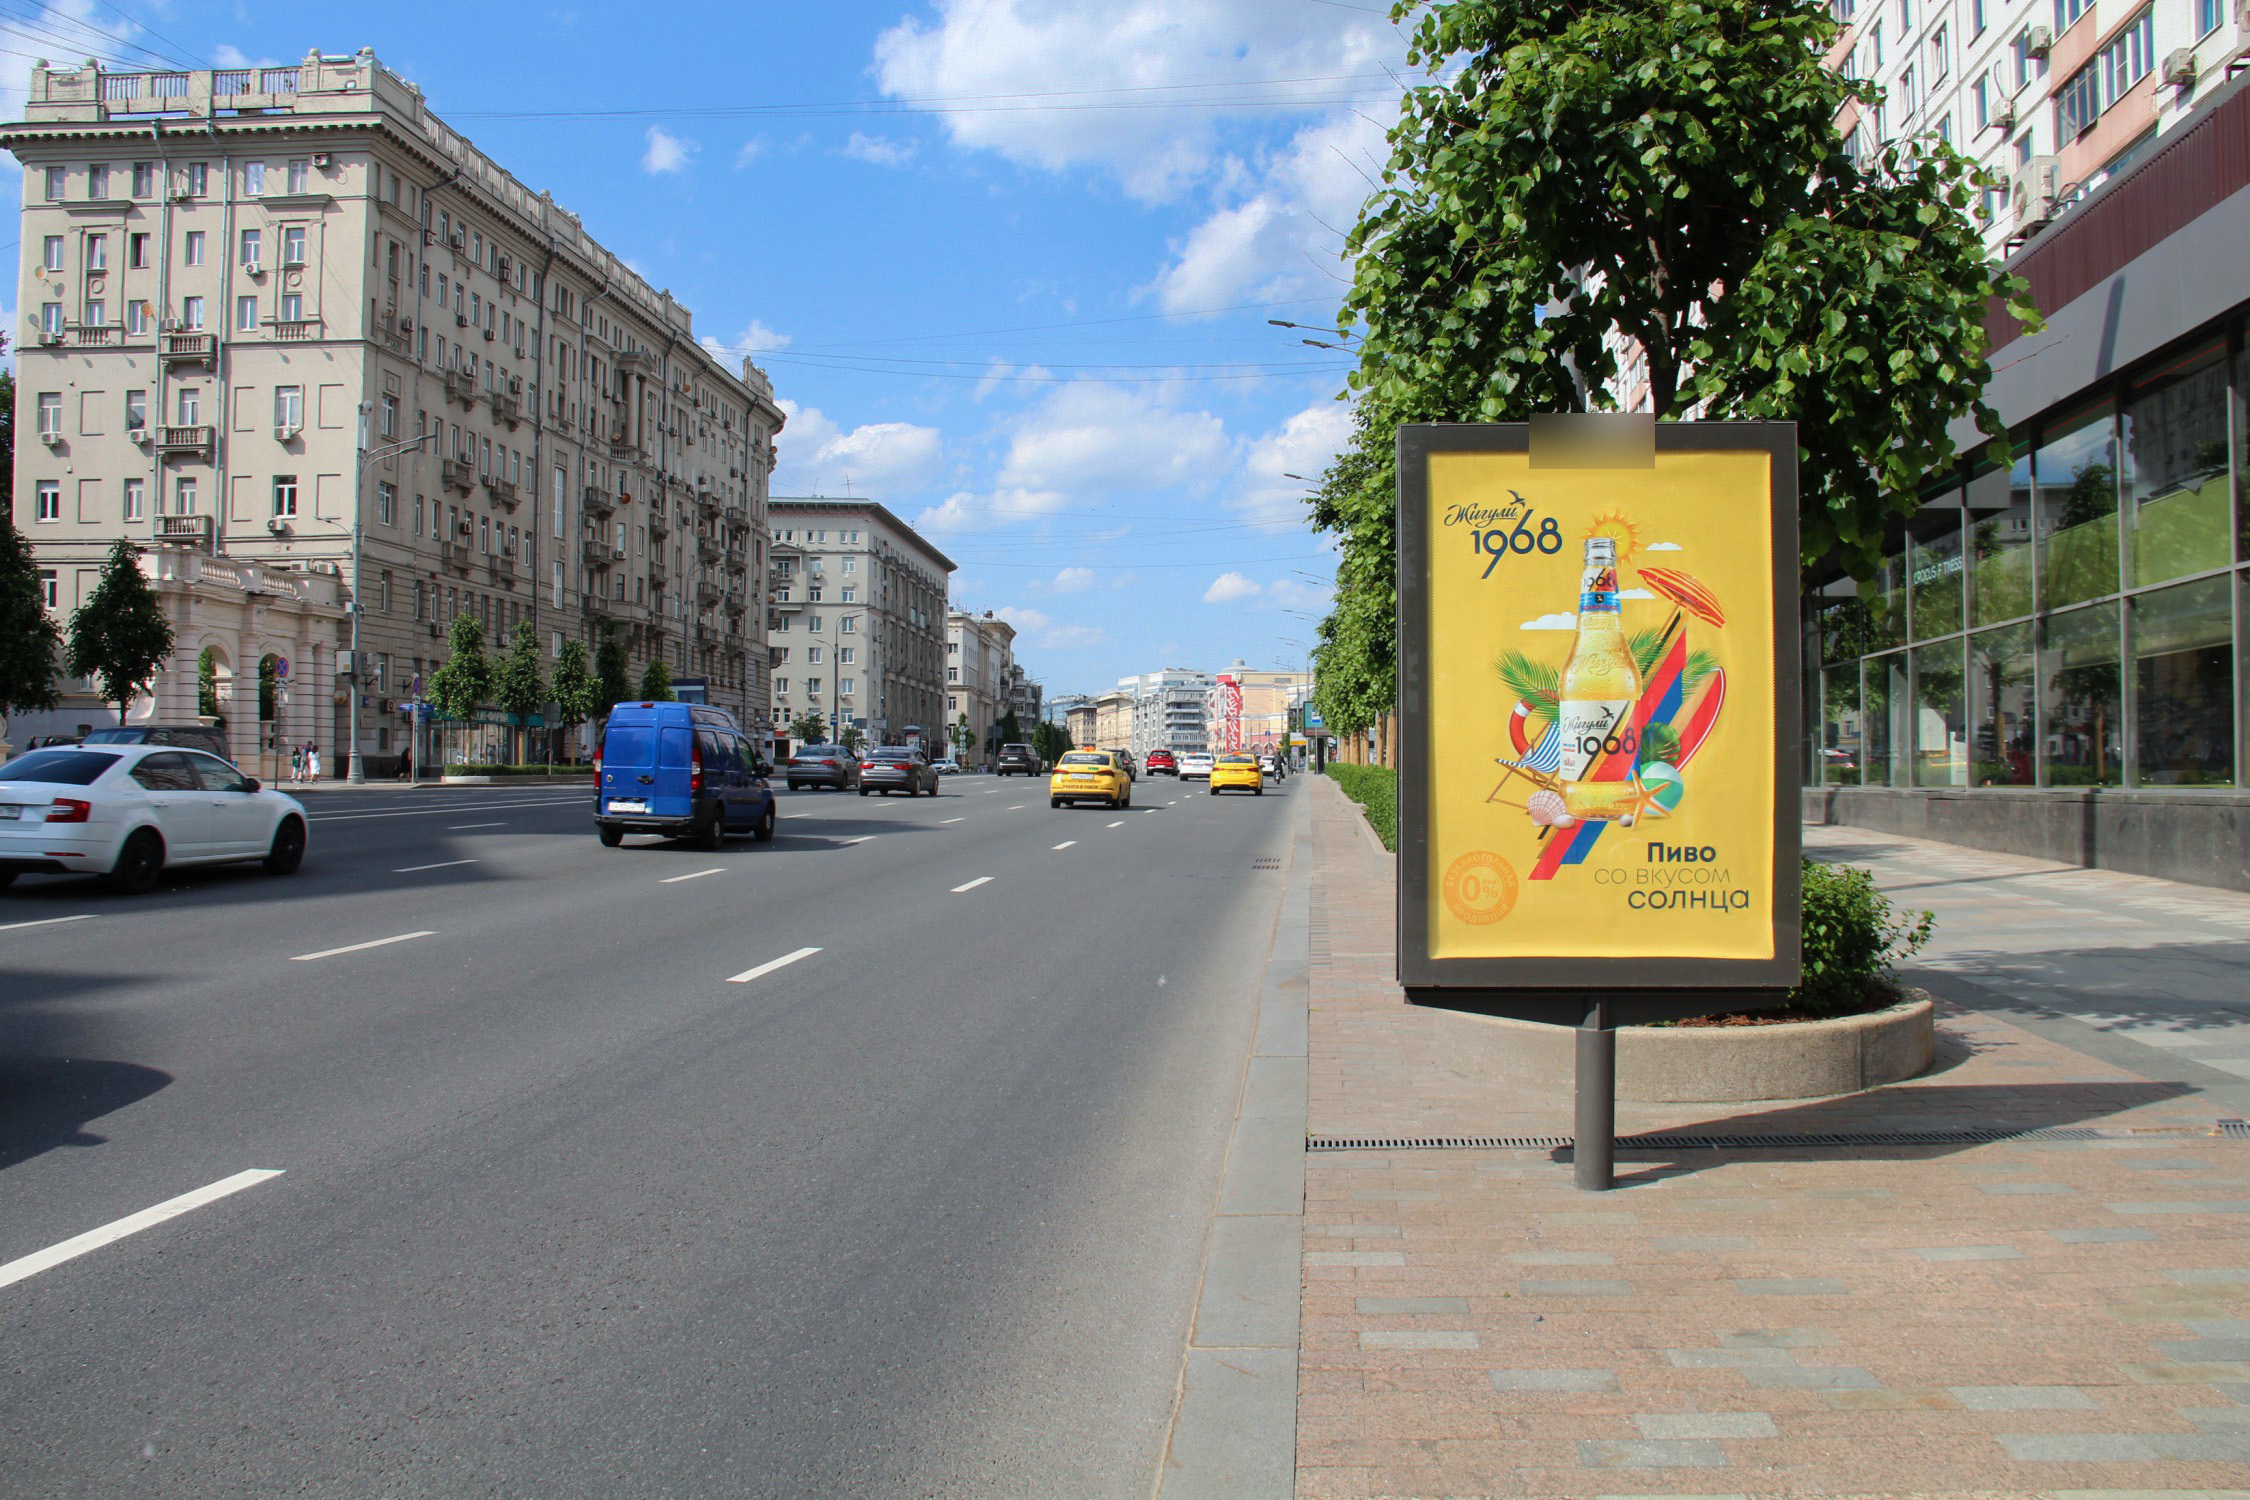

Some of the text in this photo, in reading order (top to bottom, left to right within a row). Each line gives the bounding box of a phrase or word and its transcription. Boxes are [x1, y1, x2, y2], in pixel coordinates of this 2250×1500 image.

[1444, 503, 1518, 528] Жигули
[1470, 509, 1562, 579] 1968
[1937, 556, 1963, 578] FTNESS
[1563, 716, 1609, 735] Жигули
[1647, 841, 1717, 863] Пиво
[1594, 867, 1731, 889] со вкусом
[1627, 889, 1750, 913] солнца
